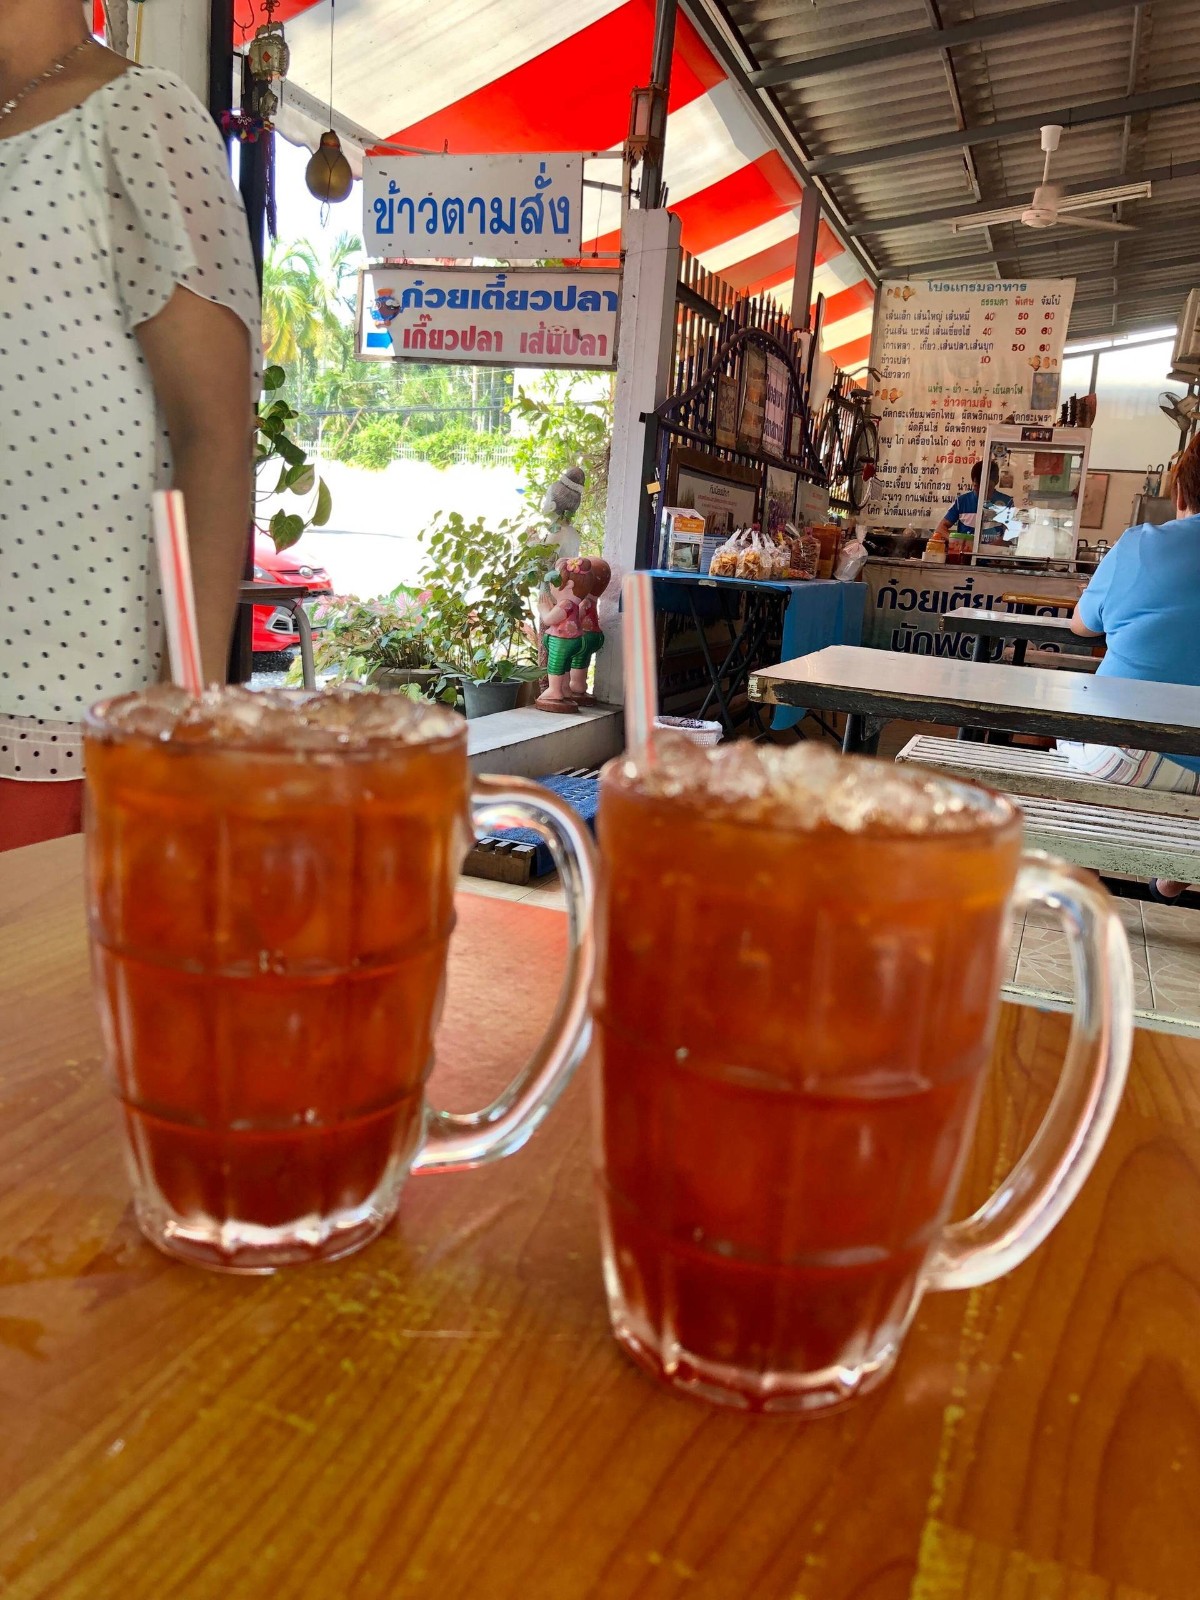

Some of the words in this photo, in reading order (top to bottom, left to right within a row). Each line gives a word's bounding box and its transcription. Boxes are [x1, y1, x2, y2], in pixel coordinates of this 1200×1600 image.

[374, 162, 570, 235] ข้าวตามสั่ง
[400, 274, 619, 312] ก๋วยเตี๋ยวปลา
[927, 281, 1028, 293] โปรแกรมอาหาร
[1014, 296, 1035, 306] พิเศษ
[984, 312, 995, 321] 40
[1017, 312, 1029, 320] 50
[1044, 312, 1055, 320] 60
[403, 314, 503, 353] เกี๊ยวปลา
[982, 327, 992, 336] 40
[1014, 327, 1027, 336] 50
[1040, 327, 1053, 336] 60
[1011, 343, 1026, 352] 50
[1039, 343, 1051, 352] 60
[980, 355, 991, 364] 10
[943, 394, 993, 409] ข้าวตามสั่ง
[1012, 410, 1053, 422] ัดกระเพรา
[944, 422, 987, 434] ผัดพริกหยว
[951, 439, 961, 448] 40
